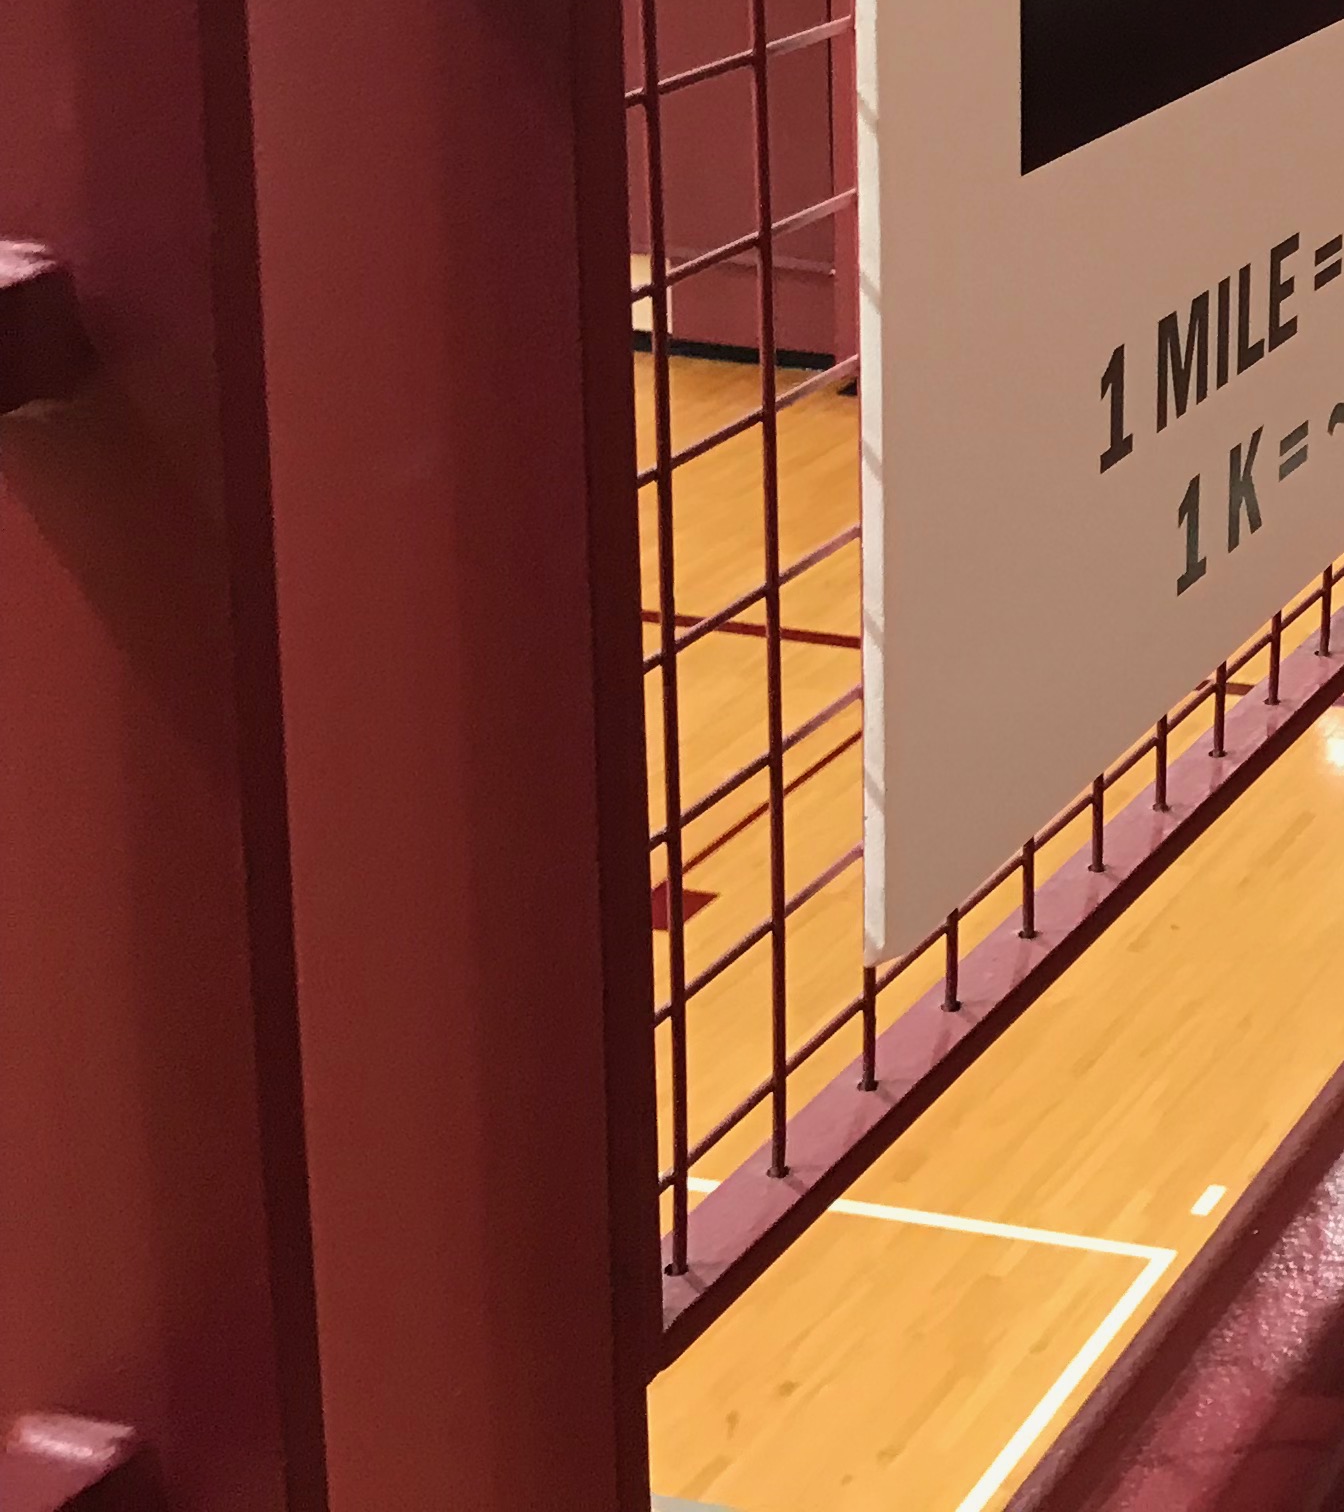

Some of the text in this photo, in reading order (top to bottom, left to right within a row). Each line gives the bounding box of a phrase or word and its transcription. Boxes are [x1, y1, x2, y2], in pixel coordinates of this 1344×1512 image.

[1099, 343, 1134, 475] 1
[1156, 232, 1300, 434] MILE
[1176, 473, 1207, 597] 1
[1227, 425, 1264, 554] K
